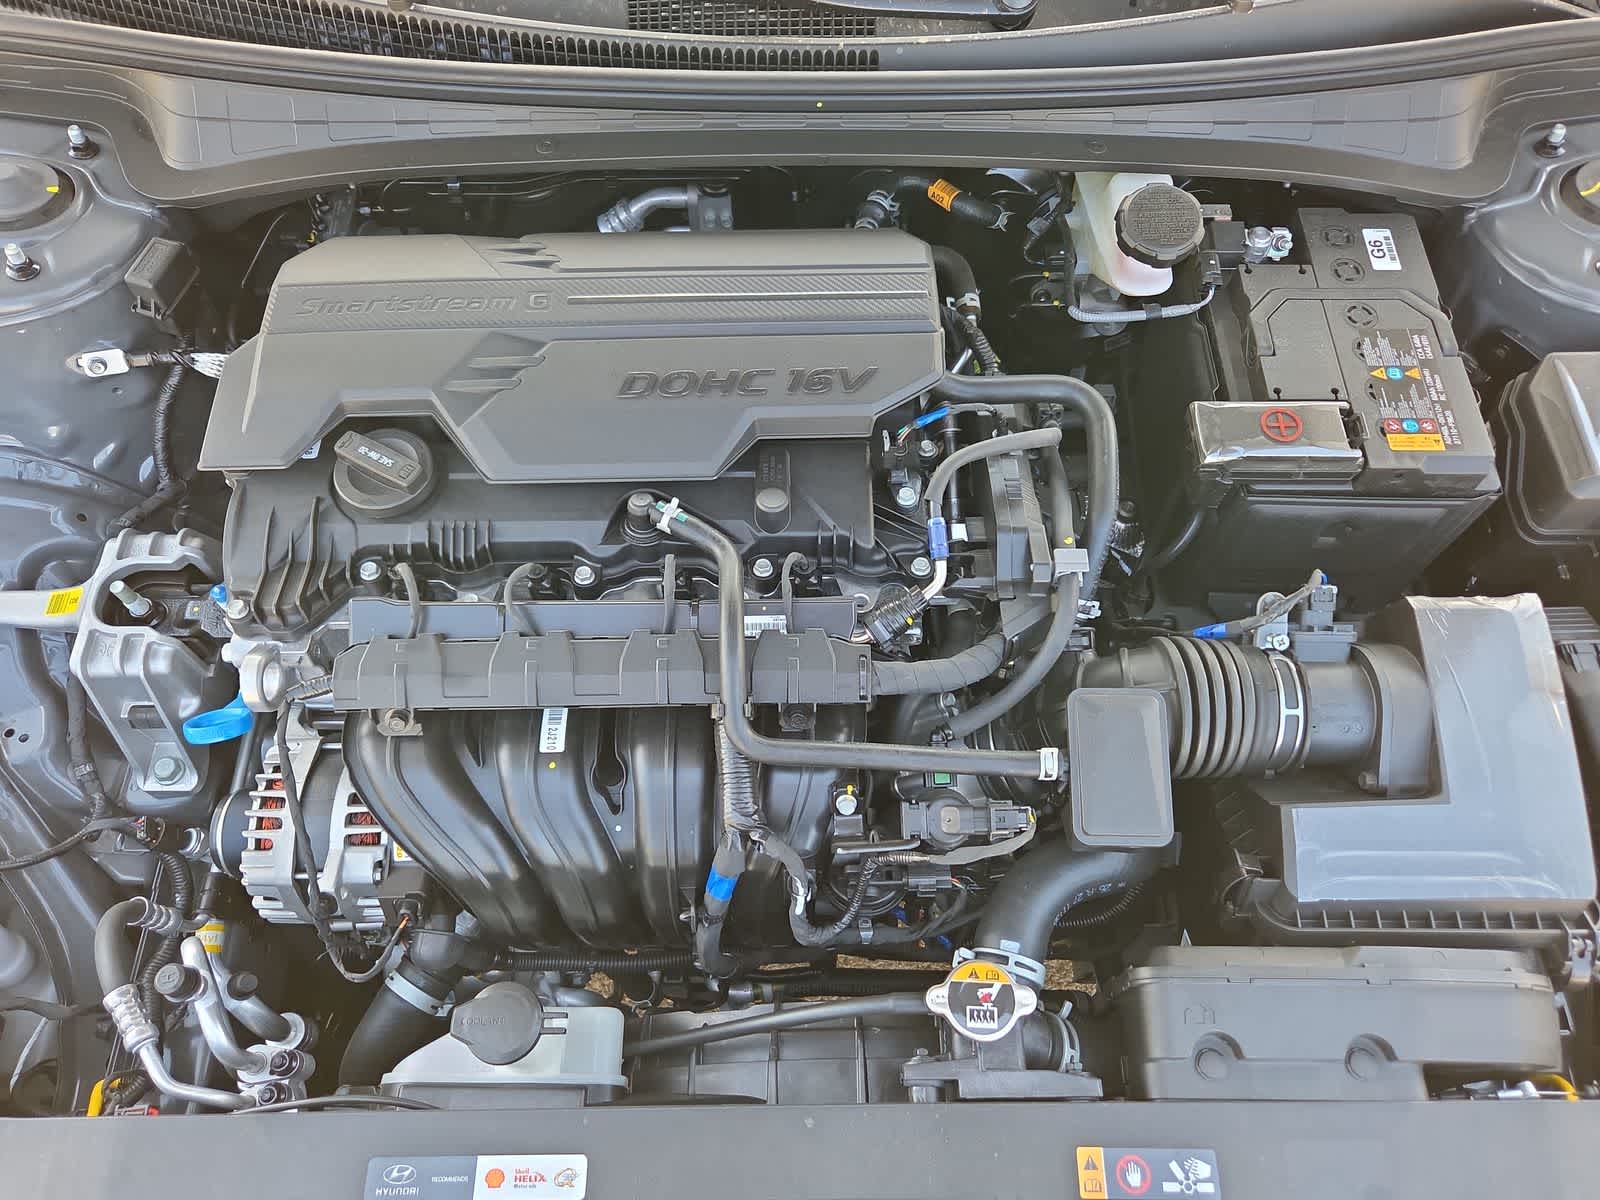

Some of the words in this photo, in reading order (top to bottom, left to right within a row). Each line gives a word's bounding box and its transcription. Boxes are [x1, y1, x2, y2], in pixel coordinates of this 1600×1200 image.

[931, 191, 944, 203] A02
[1368, 239, 1386, 259] G6
[295, 296, 517, 317] Smartstream
[526, 290, 552, 313] G
[616, 367, 776, 399] DOHC
[785, 366, 879, 395] 16V
[378, 455, 394, 466] SAE
[546, 727, 559, 751] 2J210
[514, 1174, 548, 1183] HELIX
[375, 1186, 420, 1197] HYUNDAI
